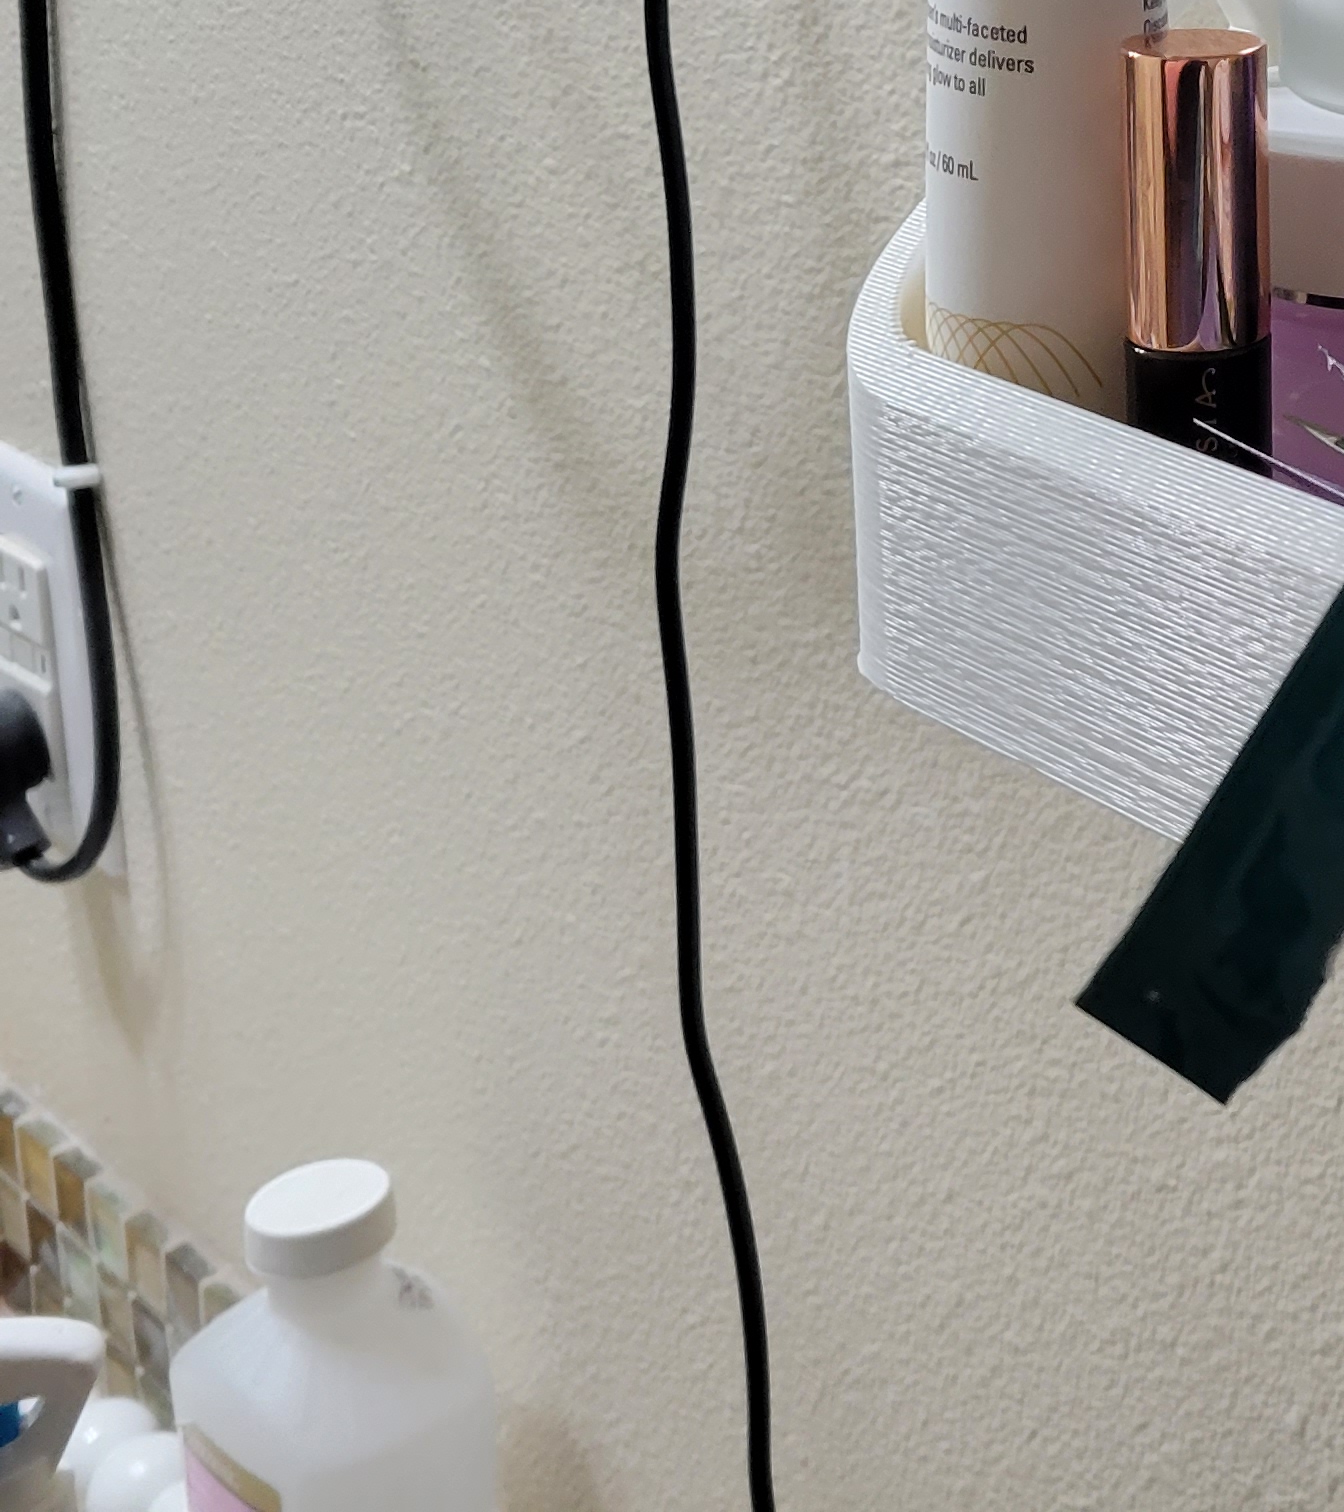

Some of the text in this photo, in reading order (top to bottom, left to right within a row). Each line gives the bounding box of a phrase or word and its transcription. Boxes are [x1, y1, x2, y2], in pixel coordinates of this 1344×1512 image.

[939, 12, 1028, 45] multi-faceted
[969, 47, 1035, 74] delivers
[953, 74, 966, 93] to
[969, 76, 987, 97] all
[942, 155, 955, 175] 60
[957, 159, 980, 182] mL
